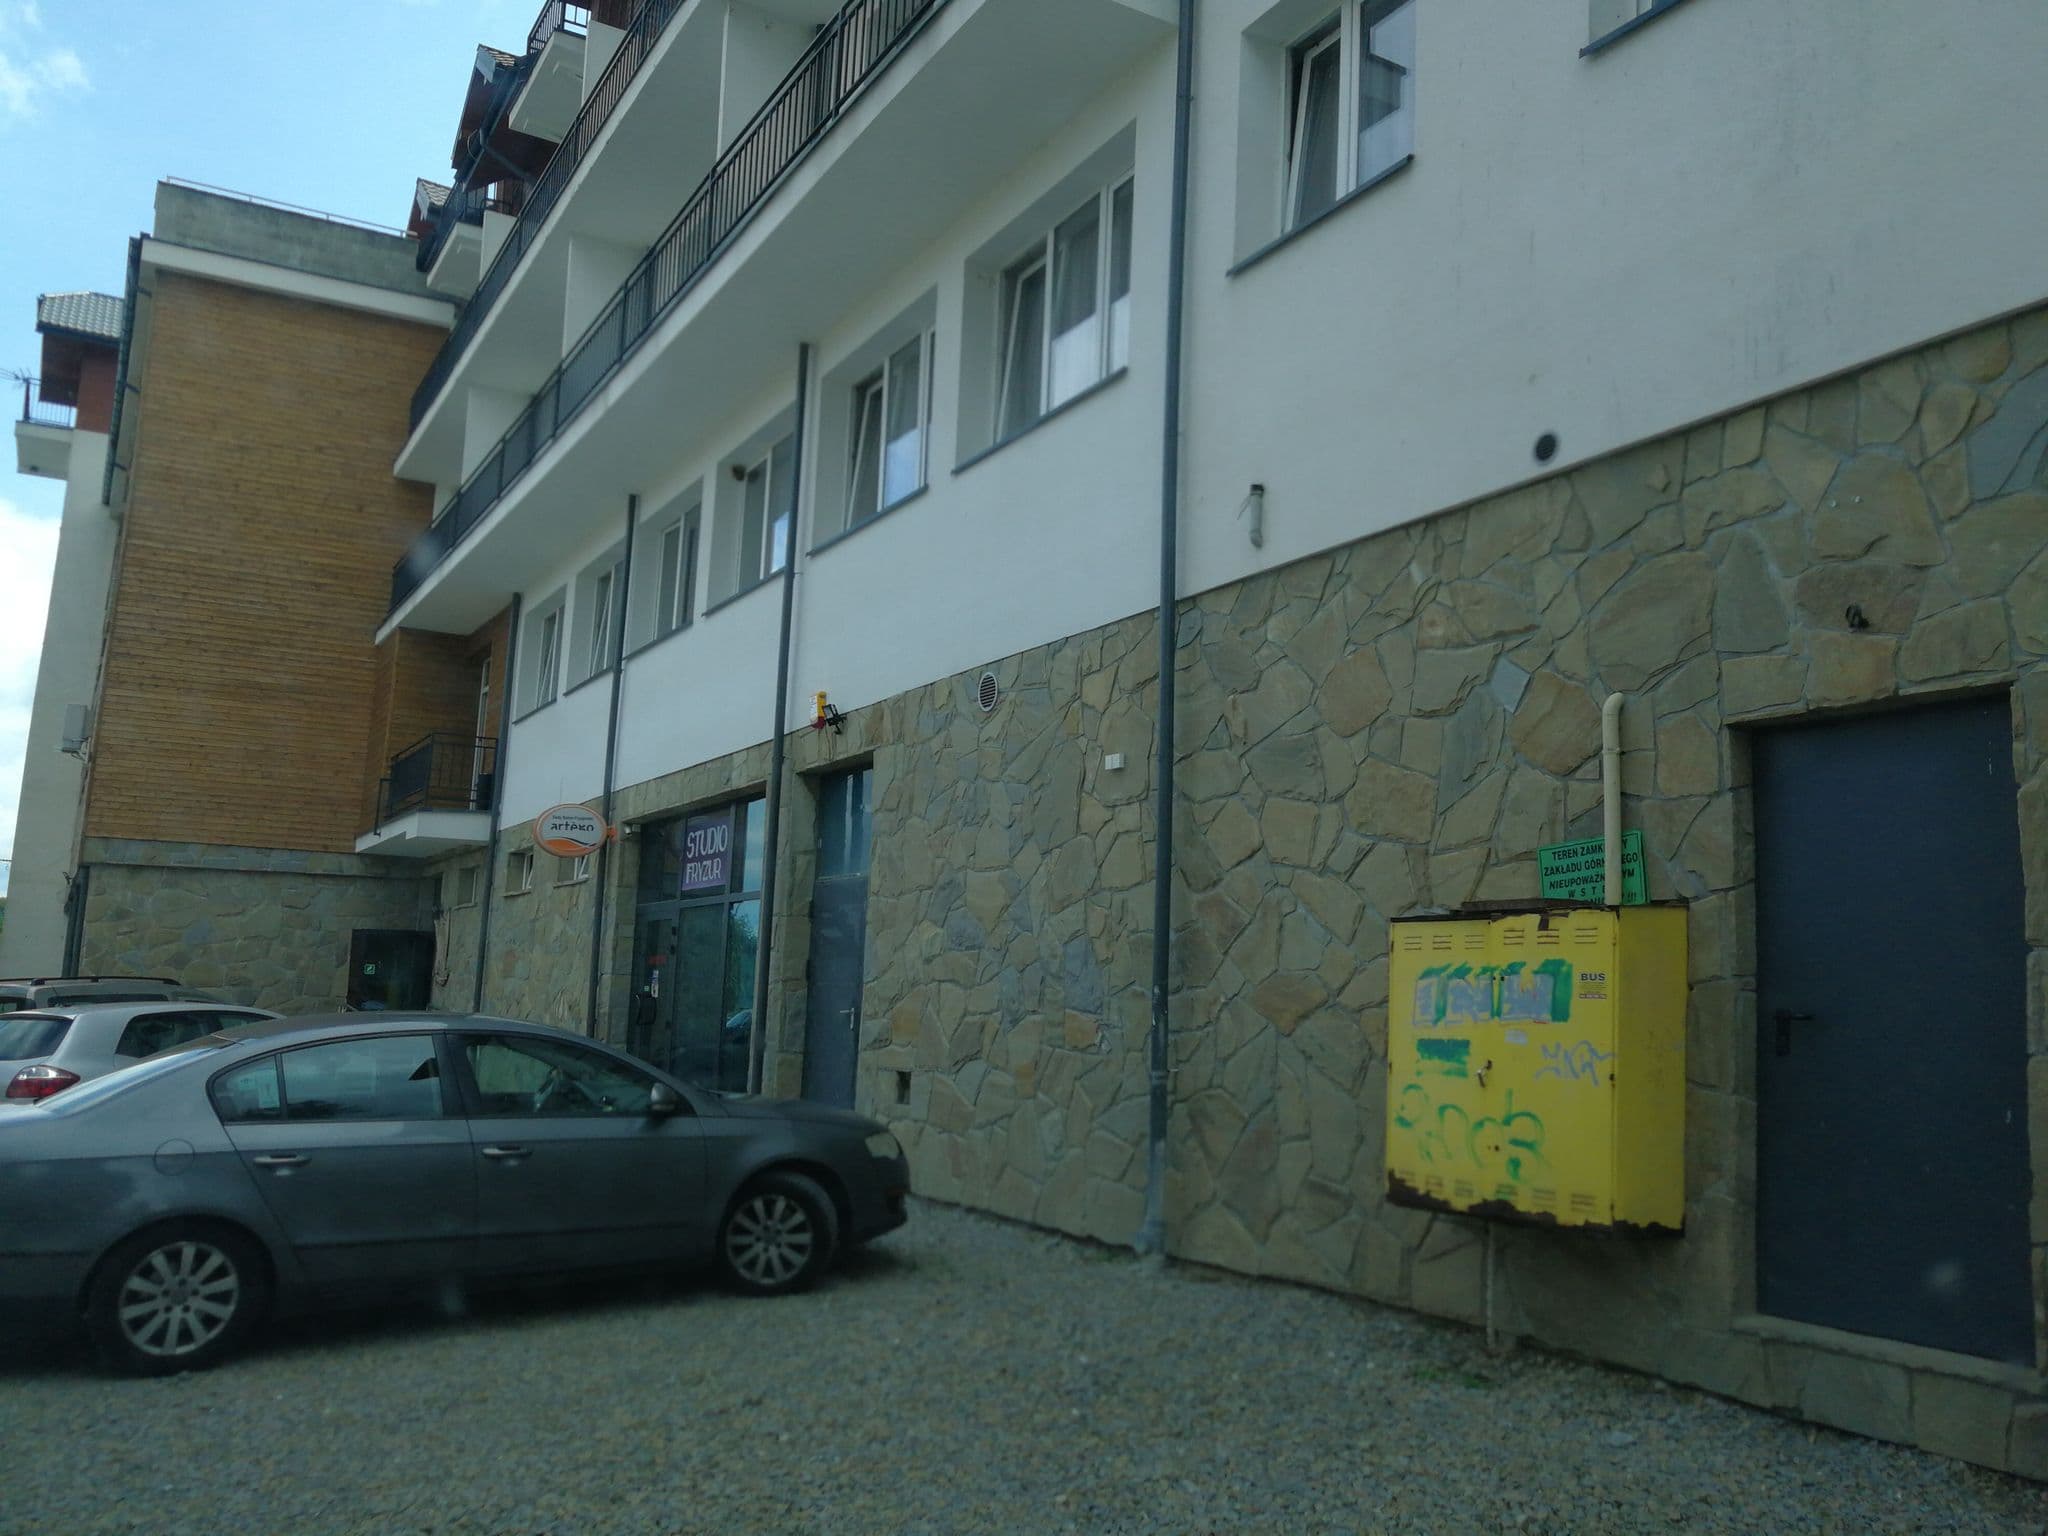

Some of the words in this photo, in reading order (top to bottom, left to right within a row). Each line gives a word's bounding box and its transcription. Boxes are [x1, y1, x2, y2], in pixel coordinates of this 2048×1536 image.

[686, 824, 728, 858] STUDIO
[1551, 848, 1578, 861] TEREN
[685, 858, 721, 884] FRYZUR
[1543, 861, 1582, 877] ZAKŁADU
[1580, 972, 1606, 981] BUS
